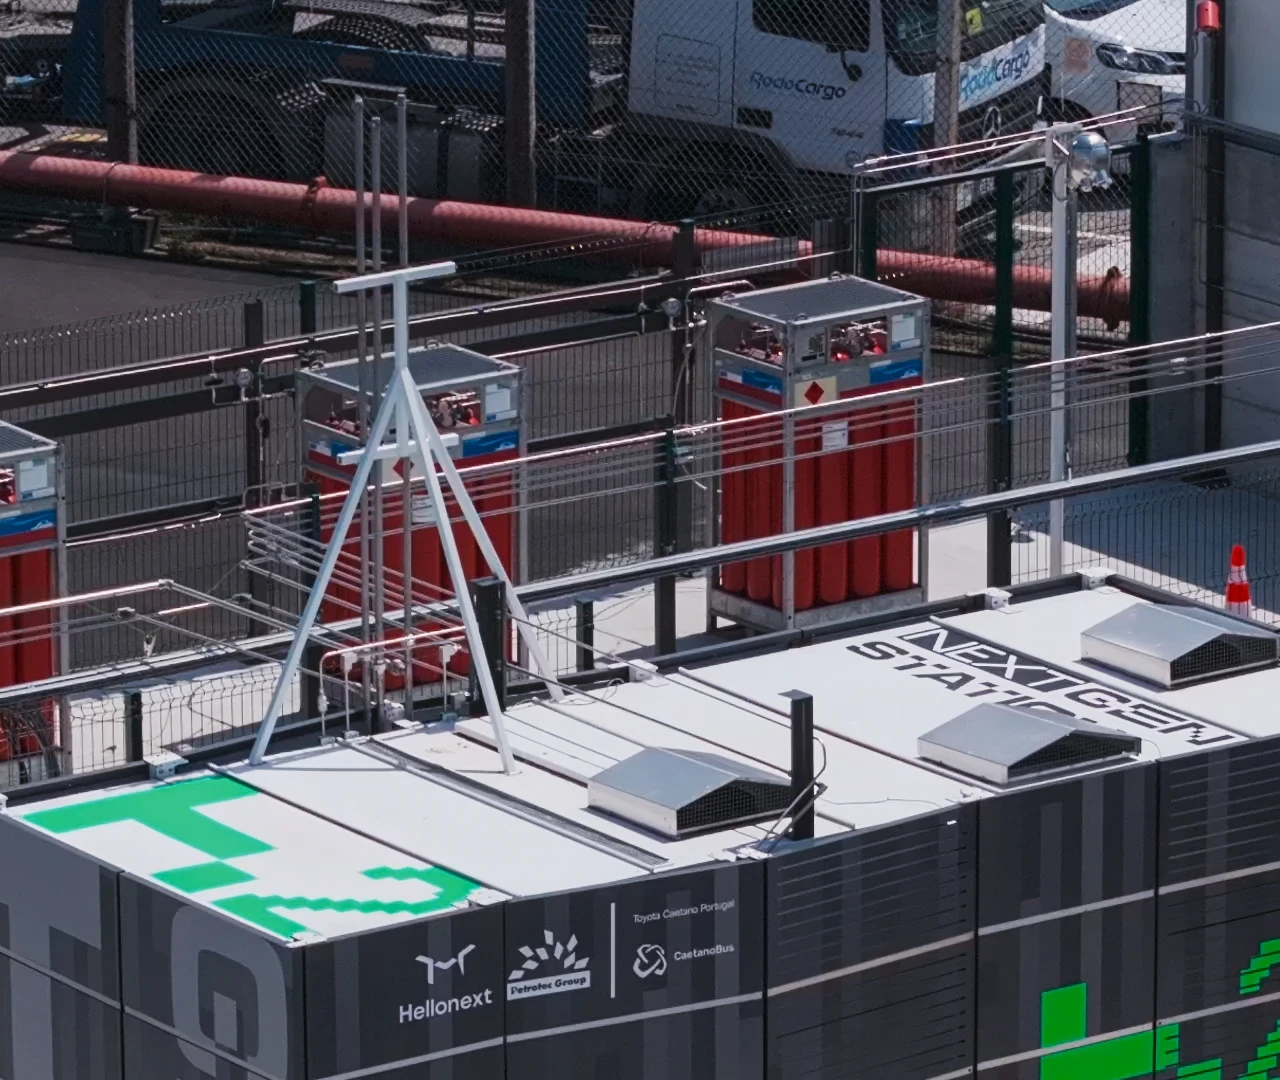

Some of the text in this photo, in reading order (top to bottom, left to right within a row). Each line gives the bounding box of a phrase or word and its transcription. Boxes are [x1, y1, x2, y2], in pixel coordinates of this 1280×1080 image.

[750, 71, 847, 100] RodoCargo
[846, 641, 1112, 730] STATI
[901, 628, 1234, 746] NEXT GEN
[632, 899, 735, 924] Toyota Caetano Portugal
[674, 944, 735, 961] CaetanoBus
[510, 976, 587, 997] Petrotec Group
[399, 987, 493, 1024] Hellonext
